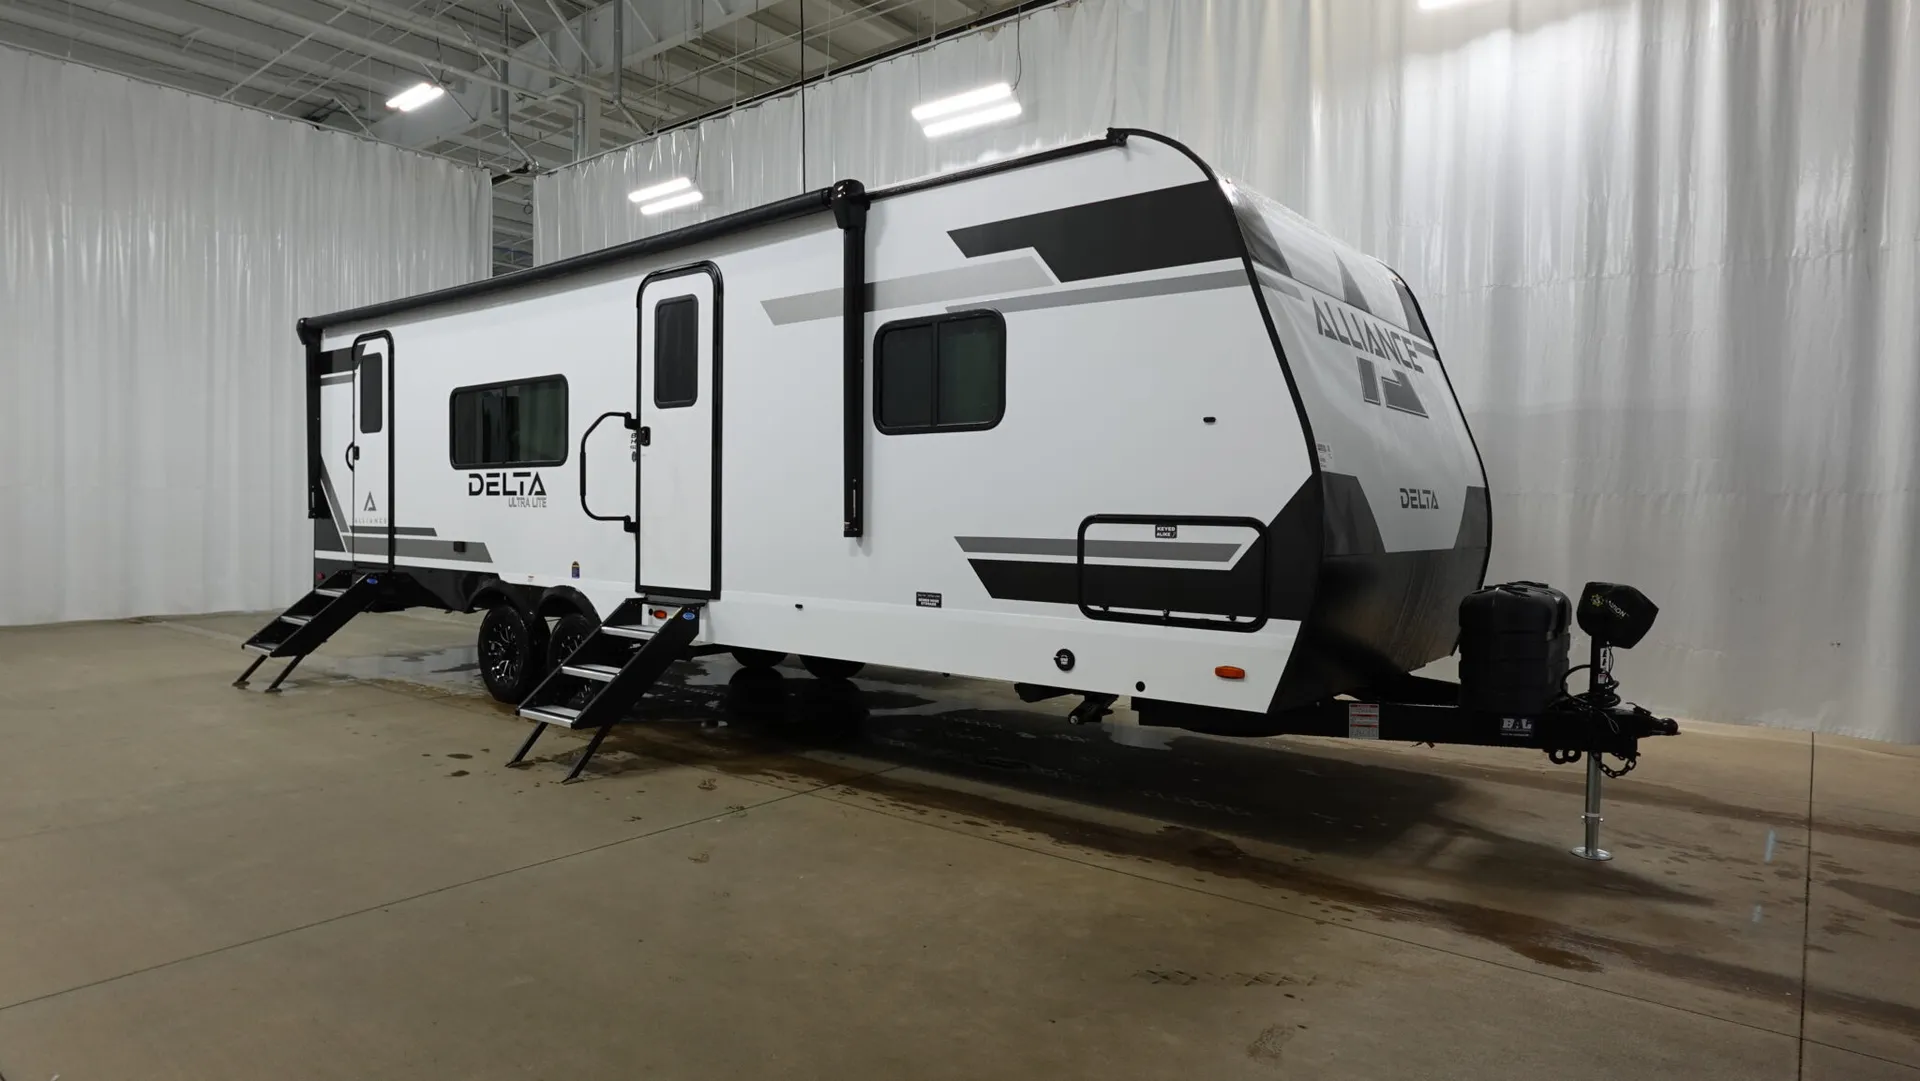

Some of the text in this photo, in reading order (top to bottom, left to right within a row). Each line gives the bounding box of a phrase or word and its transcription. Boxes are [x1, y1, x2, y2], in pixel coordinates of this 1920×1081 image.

[1311, 296, 1424, 374] ALLIANCE
[468, 472, 546, 496] DELTA
[509, 497, 546, 508] ULTRA LITE
[1399, 488, 1439, 509] DELTA
